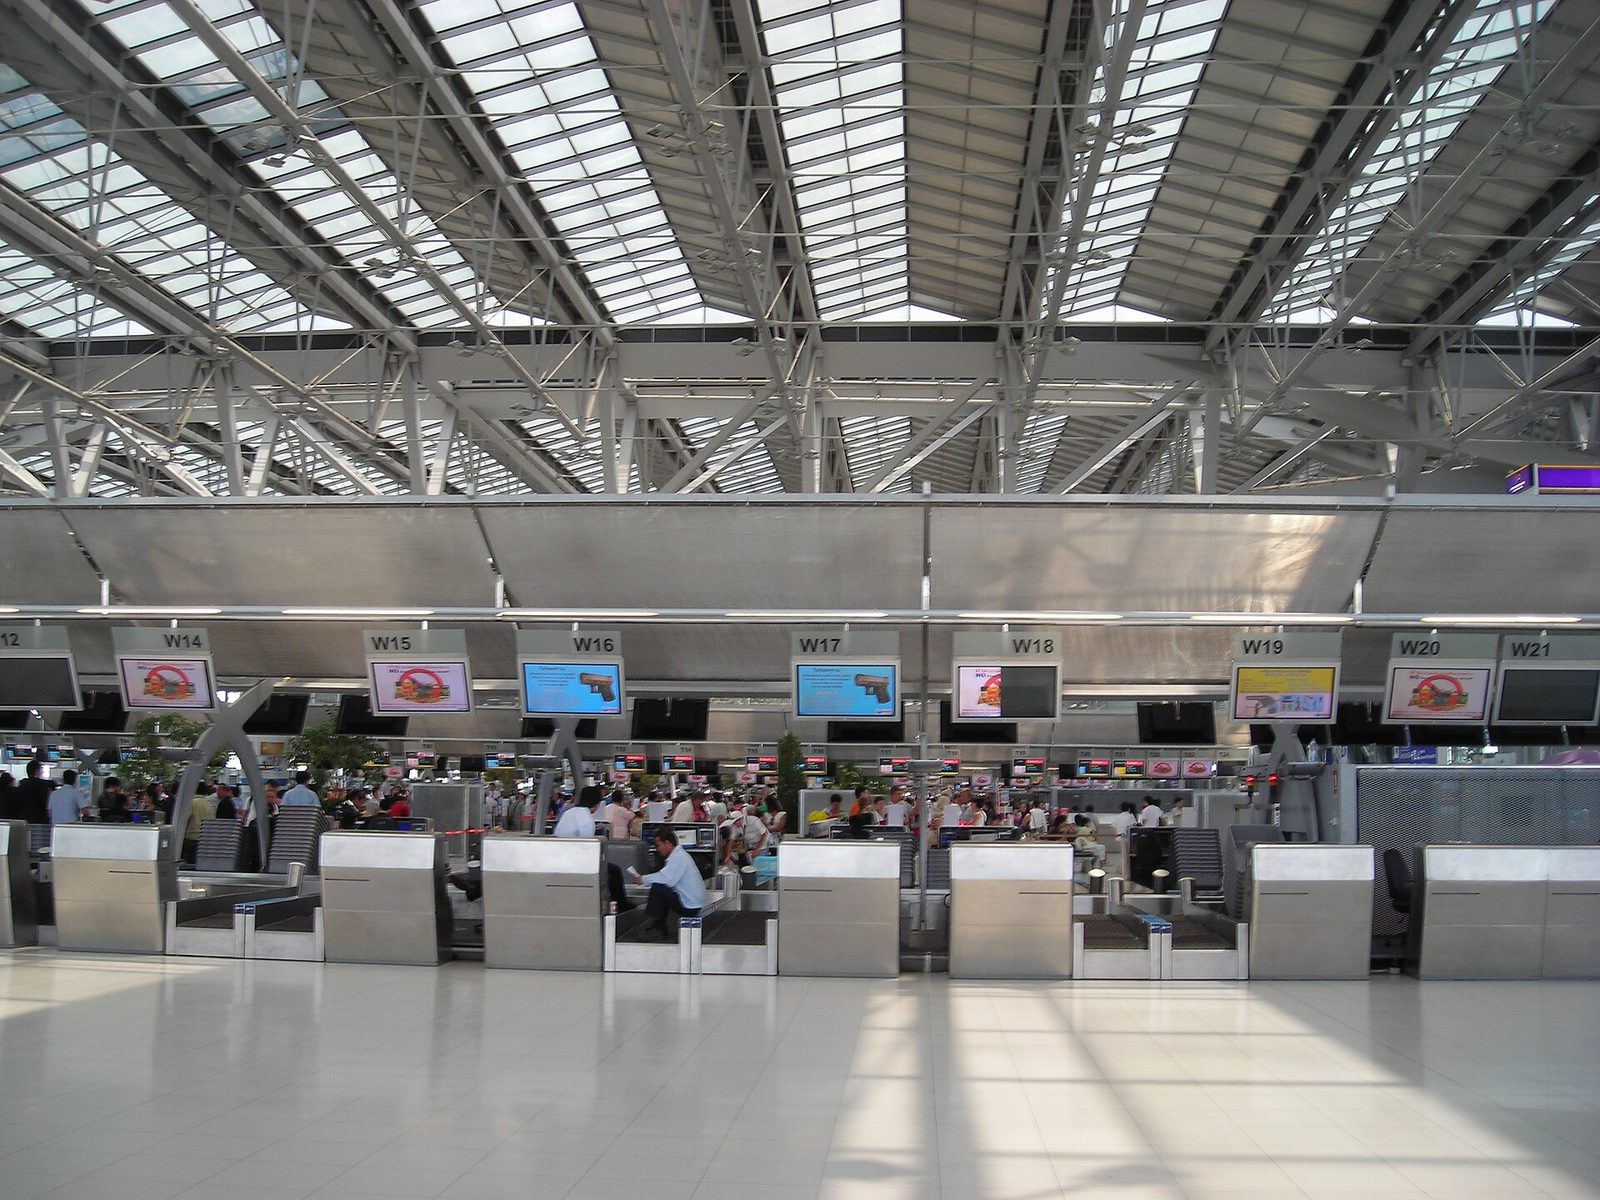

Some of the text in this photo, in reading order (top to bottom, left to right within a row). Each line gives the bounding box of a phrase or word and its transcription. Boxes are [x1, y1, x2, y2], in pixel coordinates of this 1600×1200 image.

[164, 634, 202, 648] W14
[371, 636, 412, 651] W15
[573, 637, 615, 652] W16
[800, 638, 842, 653] W17
[1013, 639, 1055, 654] W18
[1243, 640, 1284, 655] W19
[1400, 641, 1441, 656] W20
[1511, 642, 1551, 657] W21
